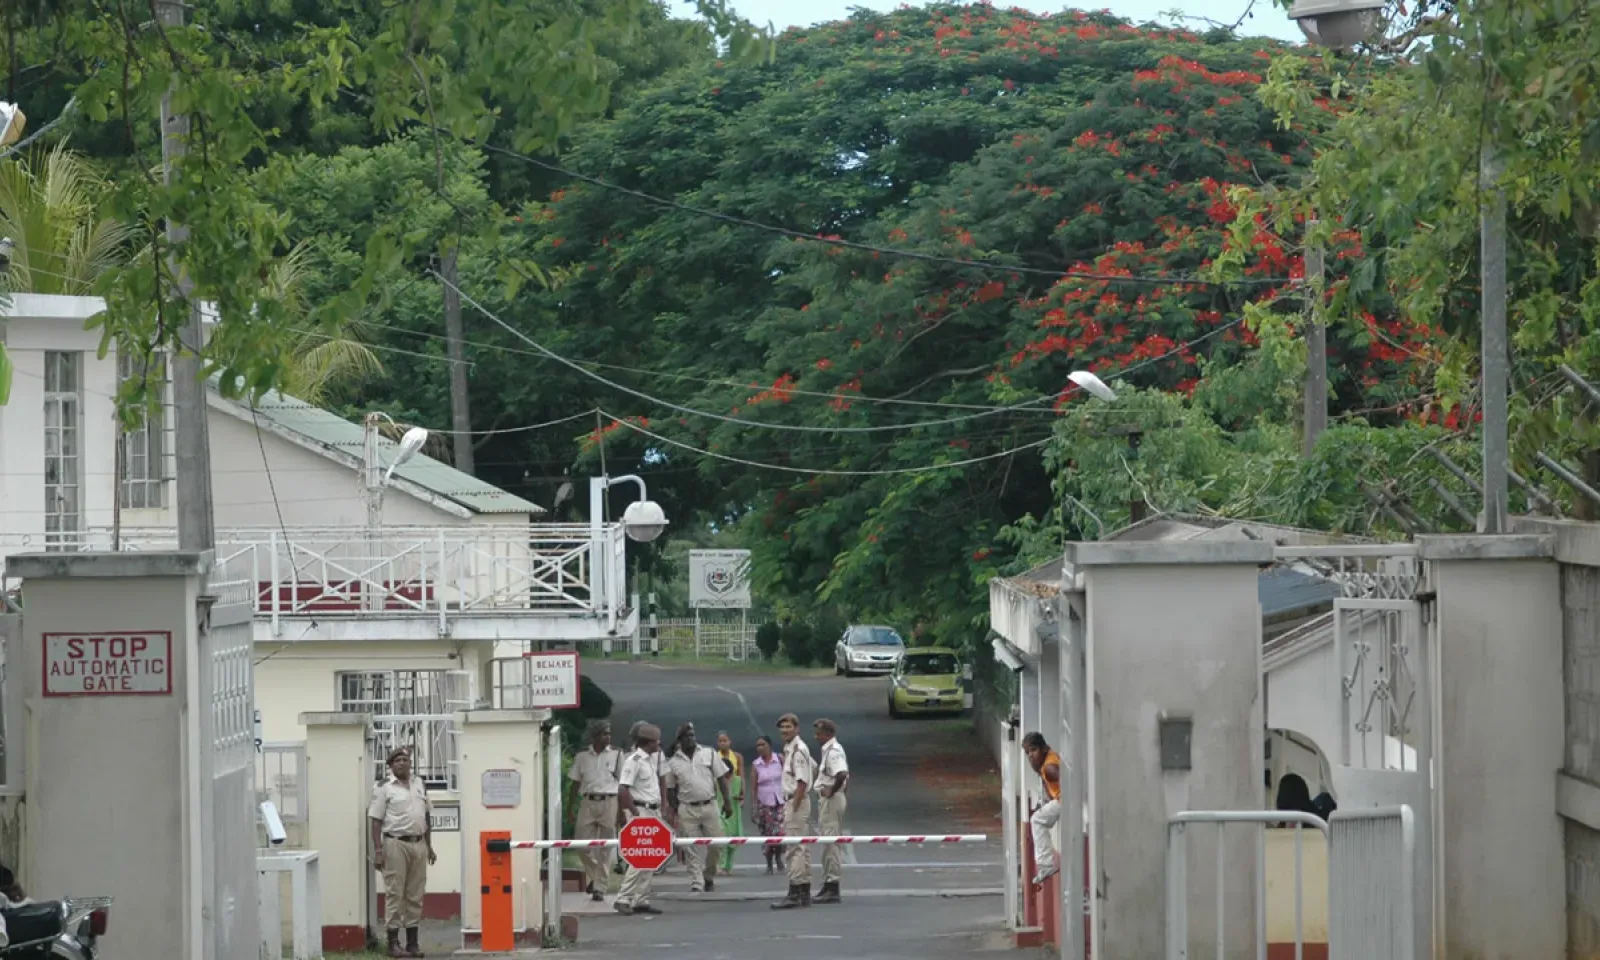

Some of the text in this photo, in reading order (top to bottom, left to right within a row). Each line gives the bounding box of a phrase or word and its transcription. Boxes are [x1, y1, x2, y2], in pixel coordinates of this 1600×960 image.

[67, 637, 147, 658] STOP
[50, 659, 164, 676] AUTOMATIC
[537, 660, 573, 668] BEWARE
[83, 675, 132, 691] GATE
[532, 687, 564, 696] ARRIER
[631, 827, 659, 836] STOP
[621, 847, 667, 856] CONTROL
